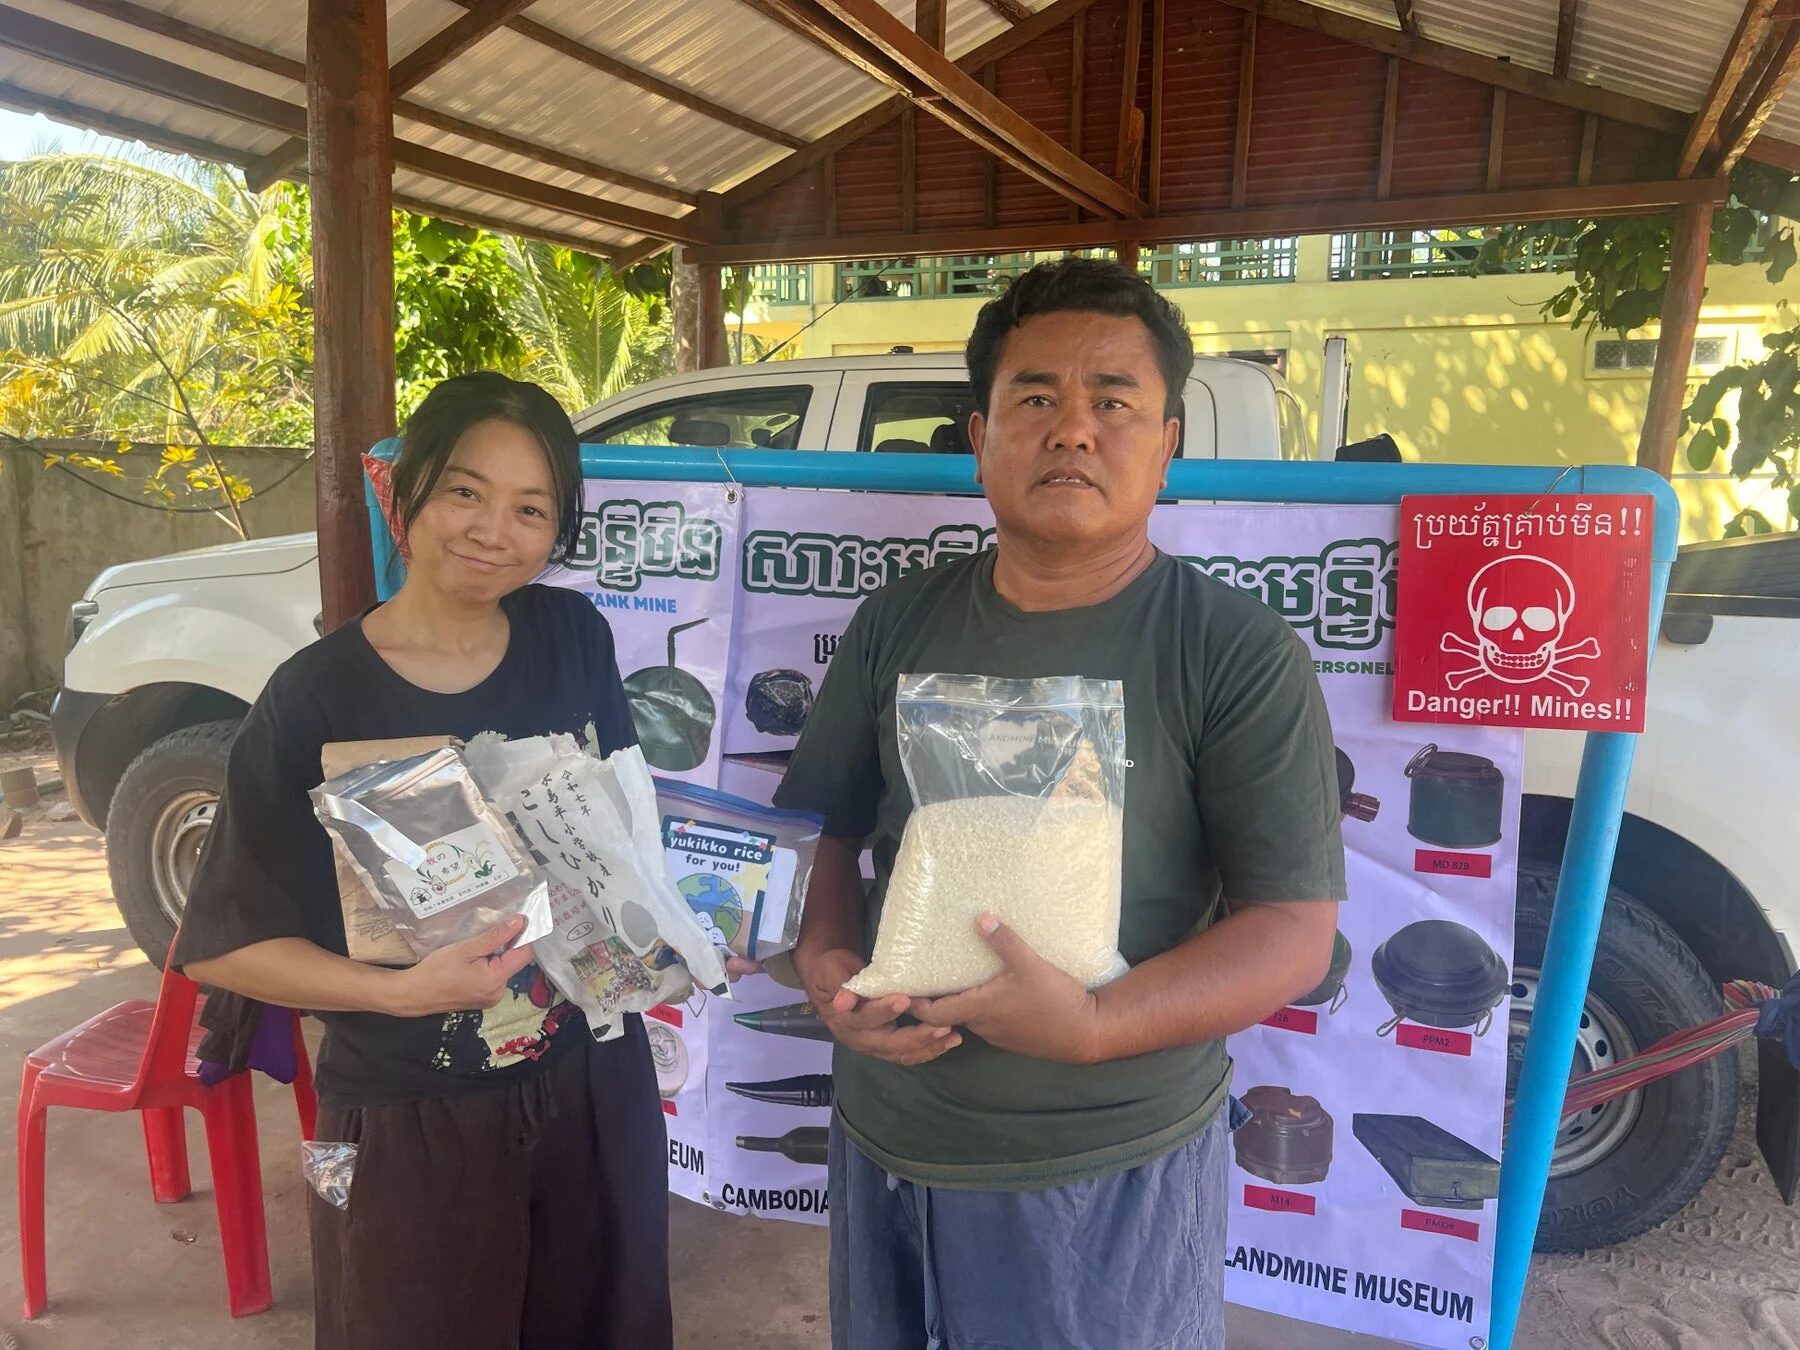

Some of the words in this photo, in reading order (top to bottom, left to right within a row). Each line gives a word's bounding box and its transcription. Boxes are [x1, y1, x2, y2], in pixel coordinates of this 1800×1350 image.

[634, 596, 677, 613] MINE
[1312, 660, 1395, 675] ERSONEL
[1408, 690, 1520, 719] Danger!!
[1531, 695, 1631, 720] Mines!!
[670, 836, 727, 855] yukikko
[733, 845, 763, 861] rice
[685, 854, 706, 866] for
[712, 861, 740, 872] you!
[1423, 1034, 1450, 1046] PPM2
[670, 1139, 704, 1175] EUM
[722, 1183, 829, 1214] CAMBODIA
[1354, 1272, 1474, 1323] MUSEUM
